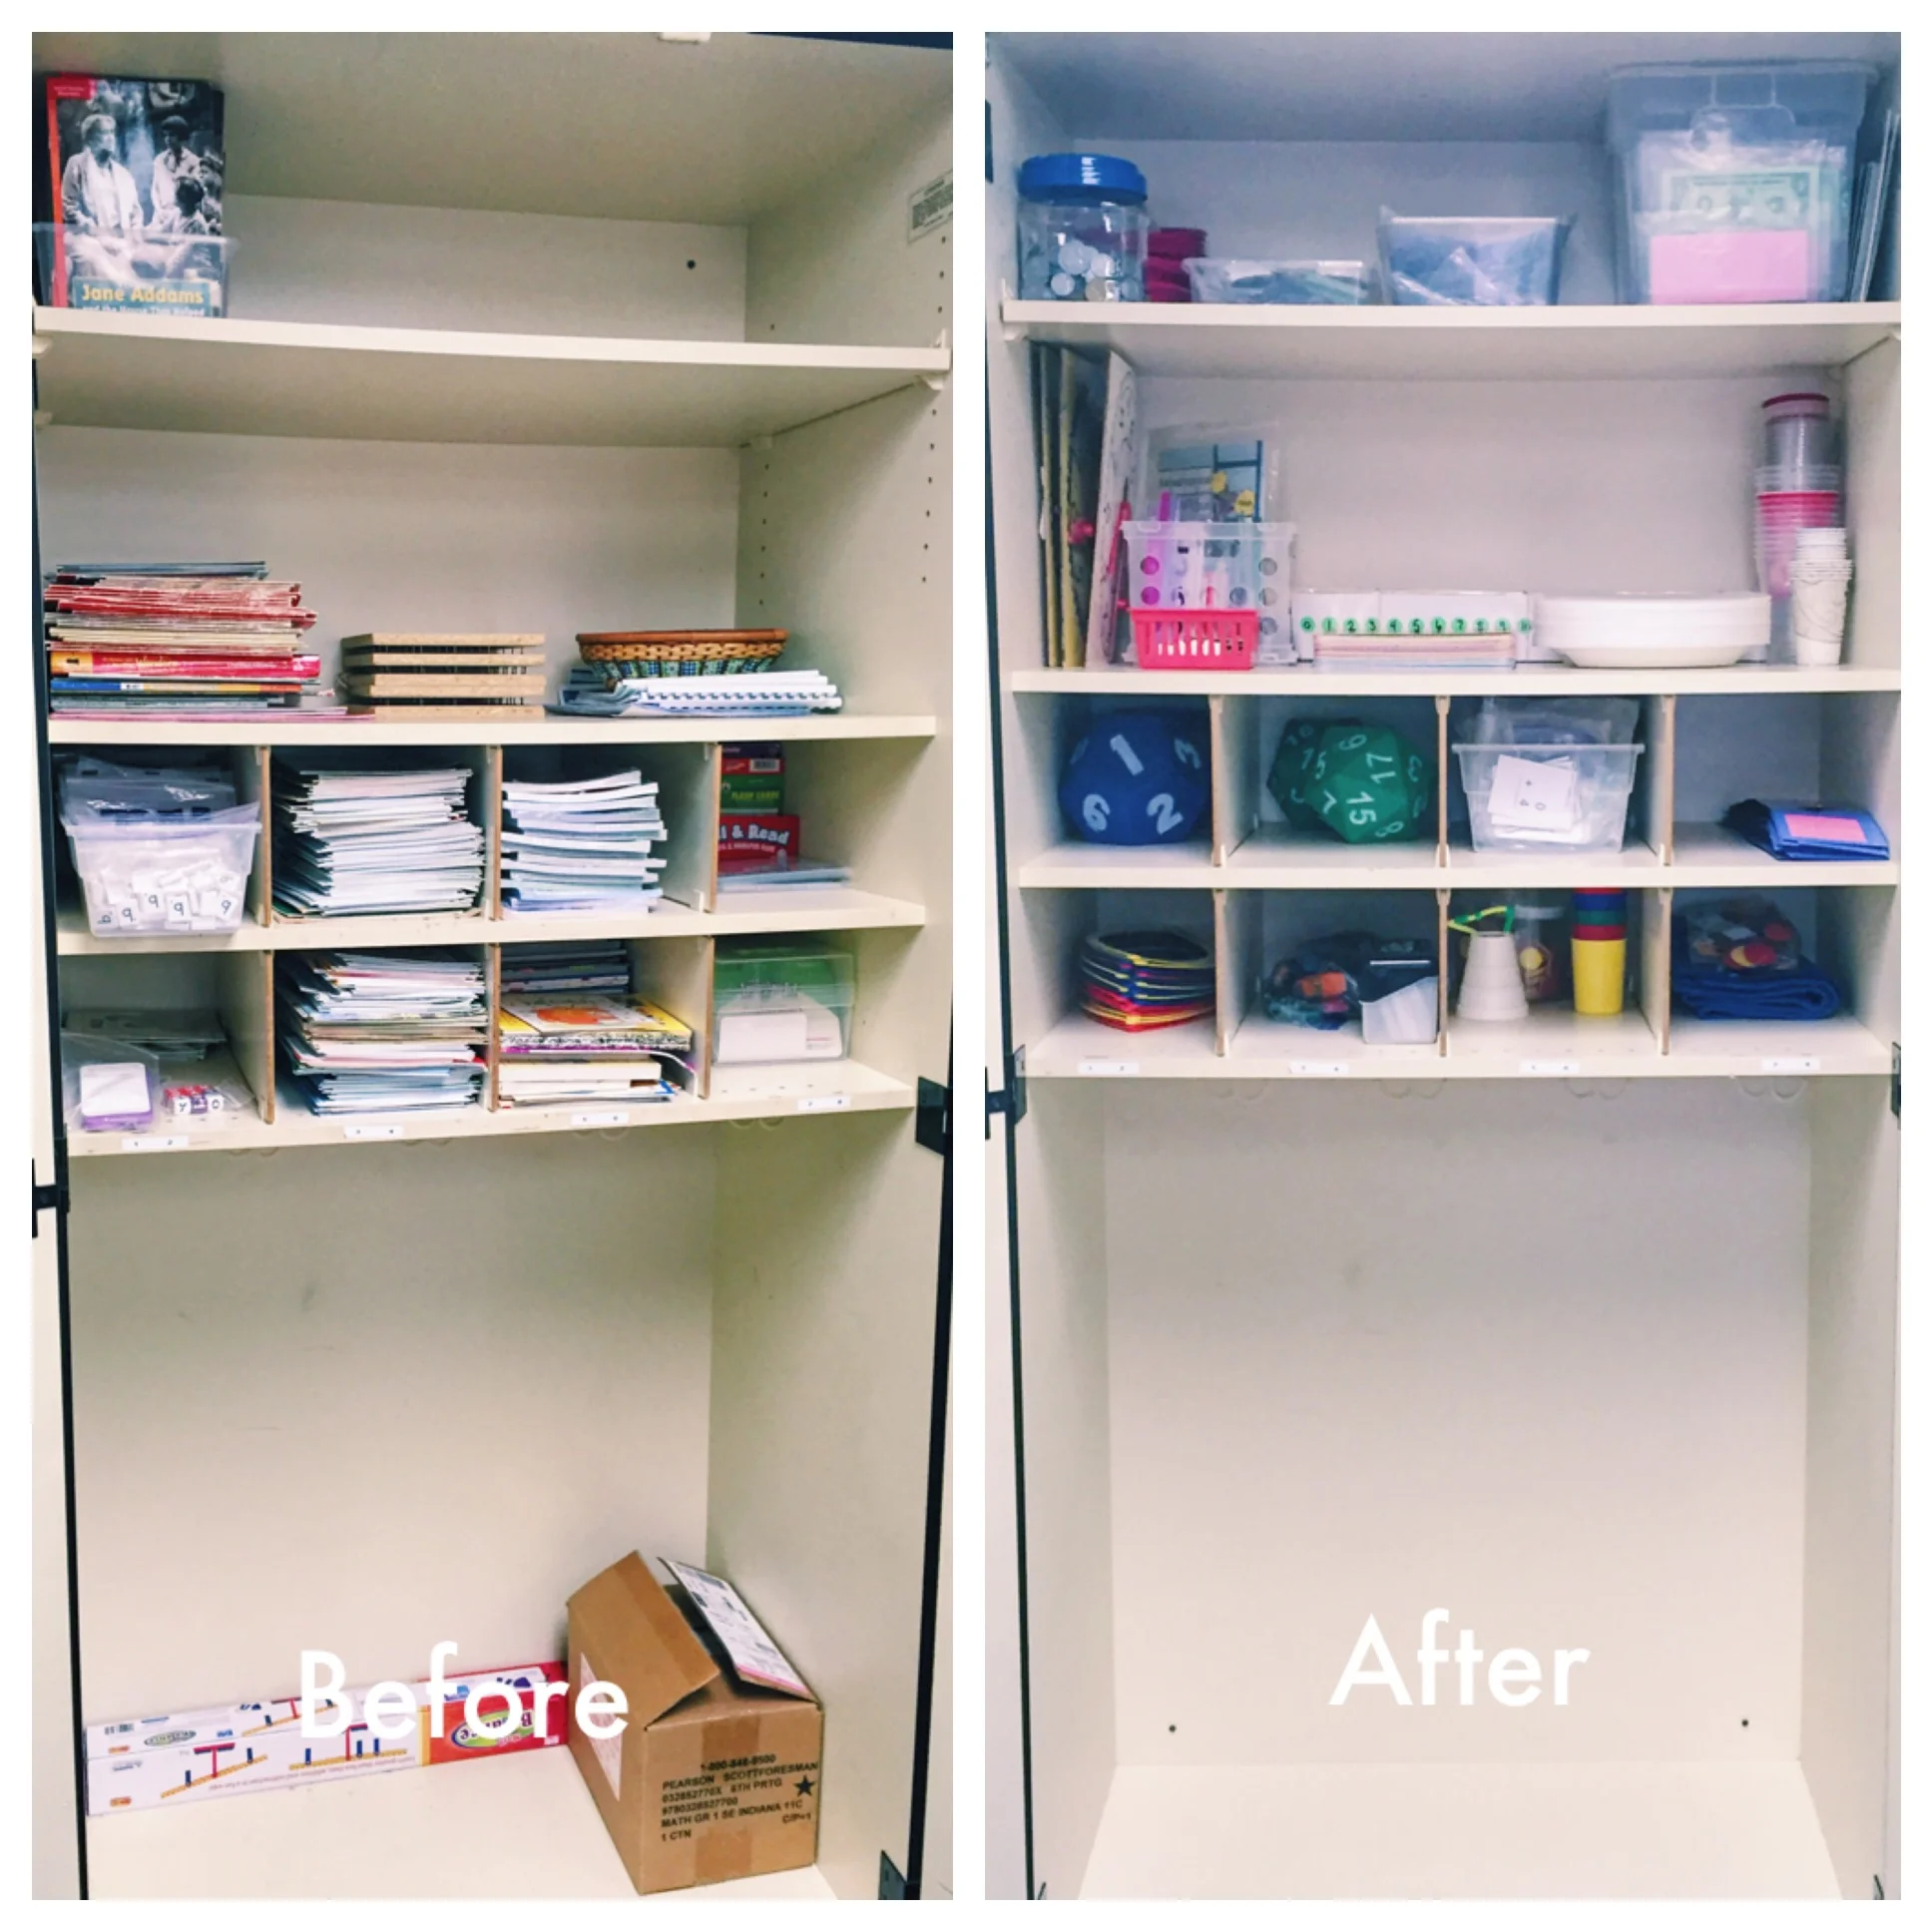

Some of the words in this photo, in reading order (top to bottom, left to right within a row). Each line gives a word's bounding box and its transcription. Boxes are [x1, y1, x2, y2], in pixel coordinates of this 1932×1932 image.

[82, 283, 125, 301] Jane
[131, 285, 205, 304] Addams
[1110, 734, 1145, 776] 1
[1083, 793, 1111, 832] 6
[1147, 793, 1184, 835] 2
[1345, 790, 1377, 825] 15
[747, 822, 790, 846] Read
[663, 1774, 715, 1790] PEARSON
[723, 1761, 818, 1782] SCOTTFORESMAN
[753, 1777, 782, 1790] PRTG
[661, 1815, 692, 1828] MATH
[694, 1812, 711, 1824] GR
[714, 1811, 719, 1821] 1
[738, 1802, 781, 1816] INDIANA
[670, 1829, 692, 1841] CTN
